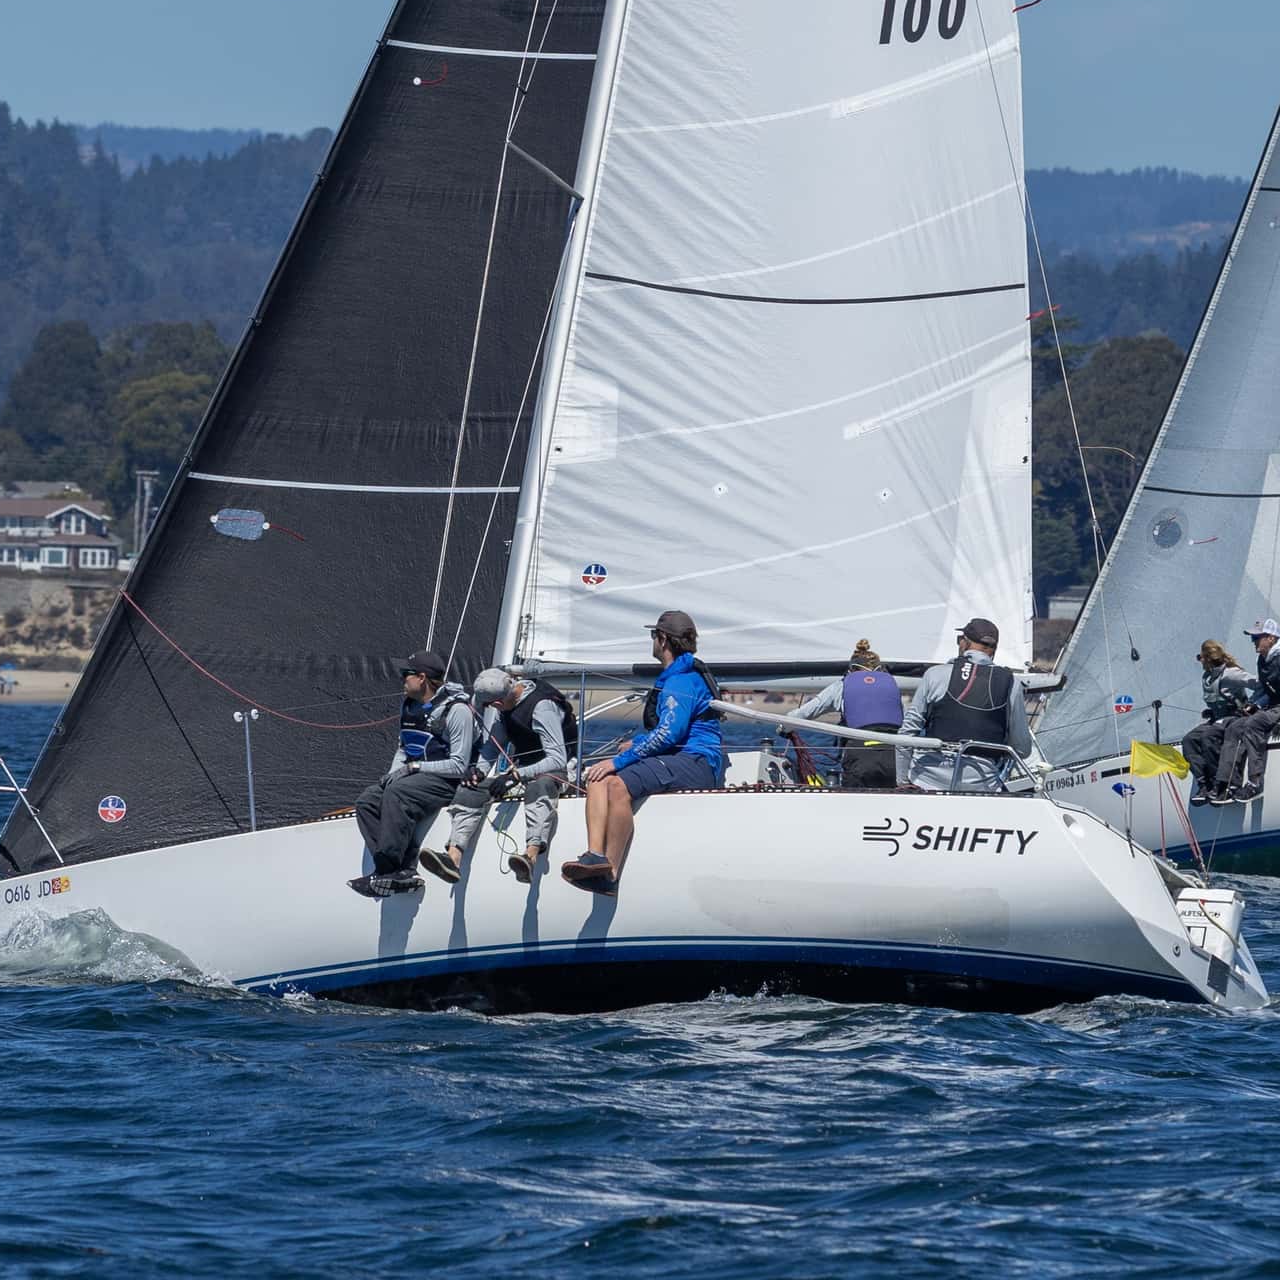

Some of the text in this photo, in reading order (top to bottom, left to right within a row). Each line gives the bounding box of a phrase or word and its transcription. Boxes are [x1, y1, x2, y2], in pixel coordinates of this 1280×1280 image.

[912, 825, 1038, 855] SHIFTY
[4, 884, 31, 904] 0616
[38, 880, 51, 898] JD
